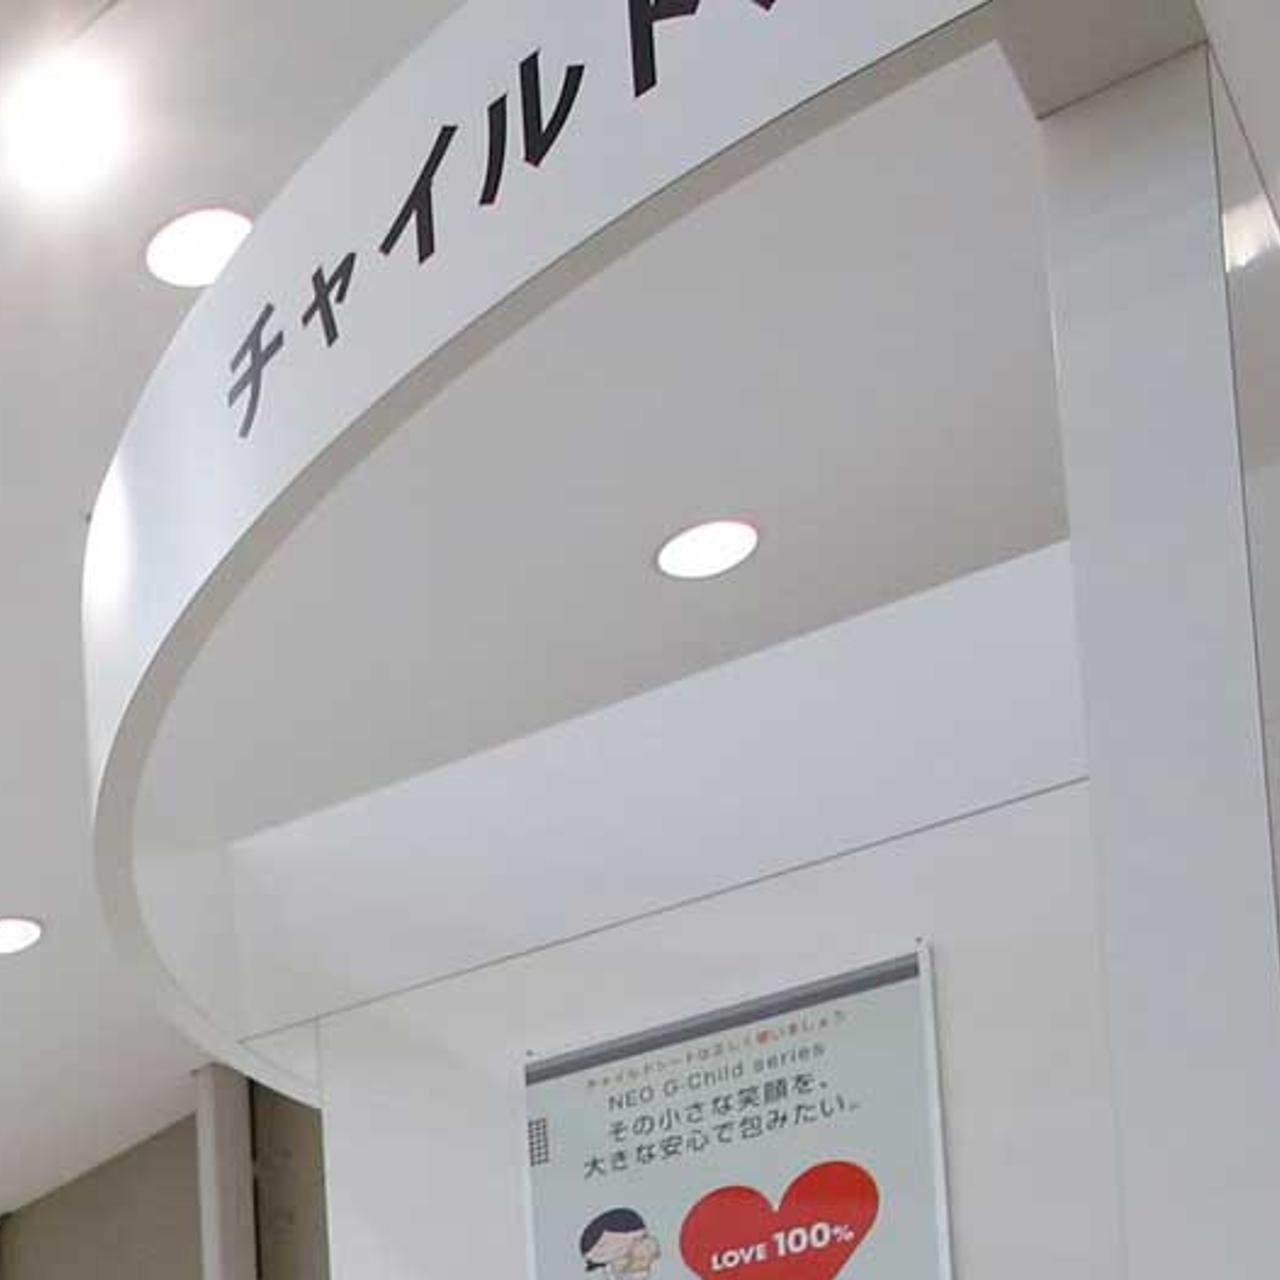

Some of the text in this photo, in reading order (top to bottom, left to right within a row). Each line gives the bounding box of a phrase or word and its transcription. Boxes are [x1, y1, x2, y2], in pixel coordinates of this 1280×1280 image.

[608, 1085, 655, 1111] NEO
[753, 1043, 826, 1073] series
[608, 1073, 829, 1142] その小さな笑顔を、
[583, 1094, 861, 1180] 大きな安心で包みたい。
[711, 1221, 855, 1271] LOVE 100%
